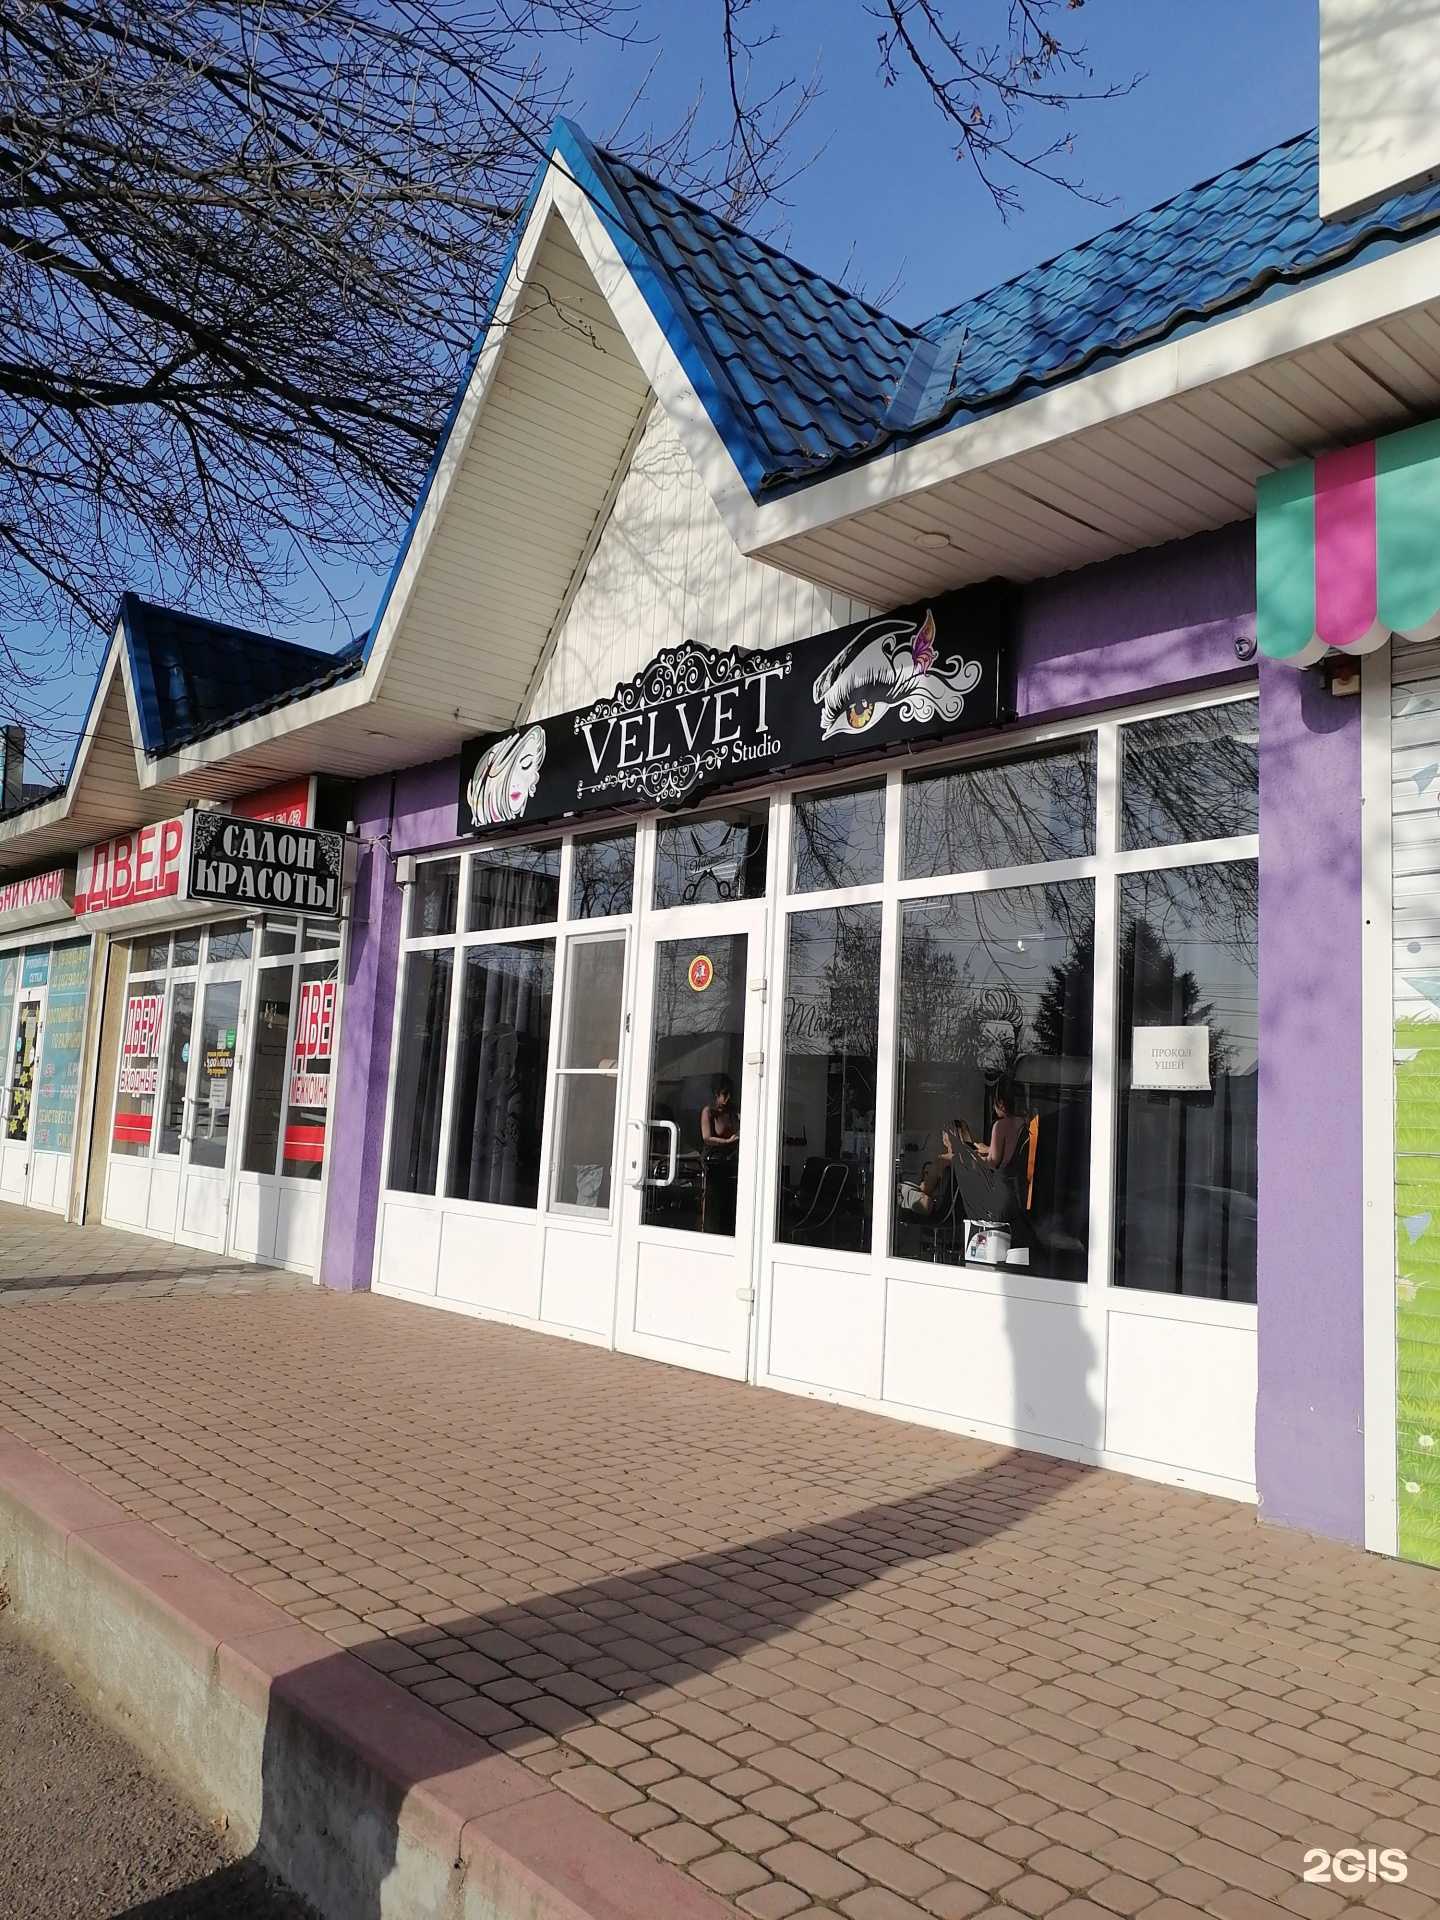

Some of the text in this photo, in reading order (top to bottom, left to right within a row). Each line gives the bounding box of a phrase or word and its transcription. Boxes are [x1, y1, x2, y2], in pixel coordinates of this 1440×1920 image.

[582, 668, 784, 774] VELVET
[731, 734, 781, 764] Studio
[222, 824, 316, 869] САЛОН
[21, 869, 64, 905] КУХНИ
[195, 859, 335, 908] КРАСОТЫ
[1151, 1048, 1192, 1058] ПРОКОЛ
[1153, 1059, 1185, 1070] УШЕЙ
[119, 1069, 158, 1096] ВХОДНЫЕ
